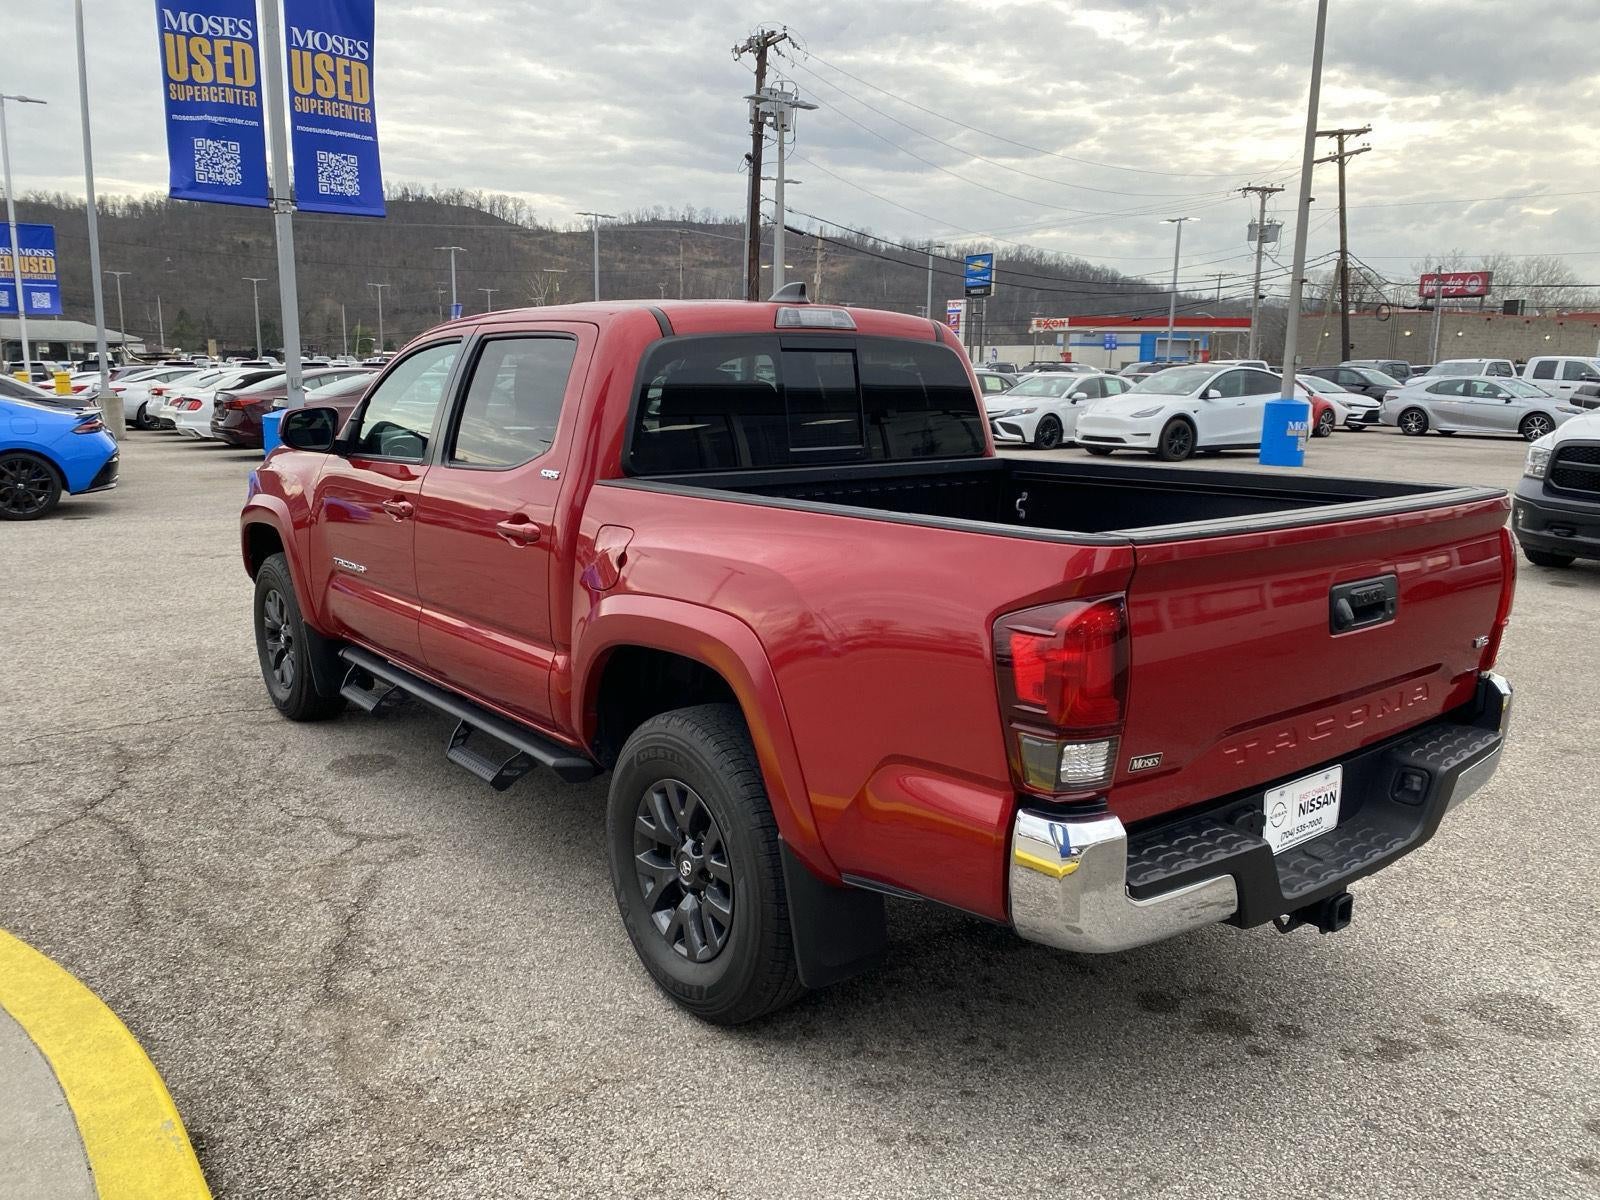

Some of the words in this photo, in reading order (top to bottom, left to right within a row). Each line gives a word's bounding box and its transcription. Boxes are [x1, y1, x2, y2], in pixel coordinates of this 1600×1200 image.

[162, 8, 253, 40] MOSES
[290, 26, 369, 61] MOSES
[164, 32, 256, 87] USED
[291, 48, 370, 104] USED
[169, 82, 258, 107] SUPERCENTER
[171, 113, 259, 127] mosesusedsupercenter.com
[294, 96, 372, 123] SUPERCENTER
[296, 125, 374, 141] mosesusedsupercenter.com
[19, 247, 54, 257] MOSES
[20, 256, 56, 273] USED
[1036, 319, 1067, 329] EXXON
[1223, 682, 1430, 764] TACOMA
[1131, 757, 1160, 770] MOSES
[1298, 790, 1337, 817] NISSAN
